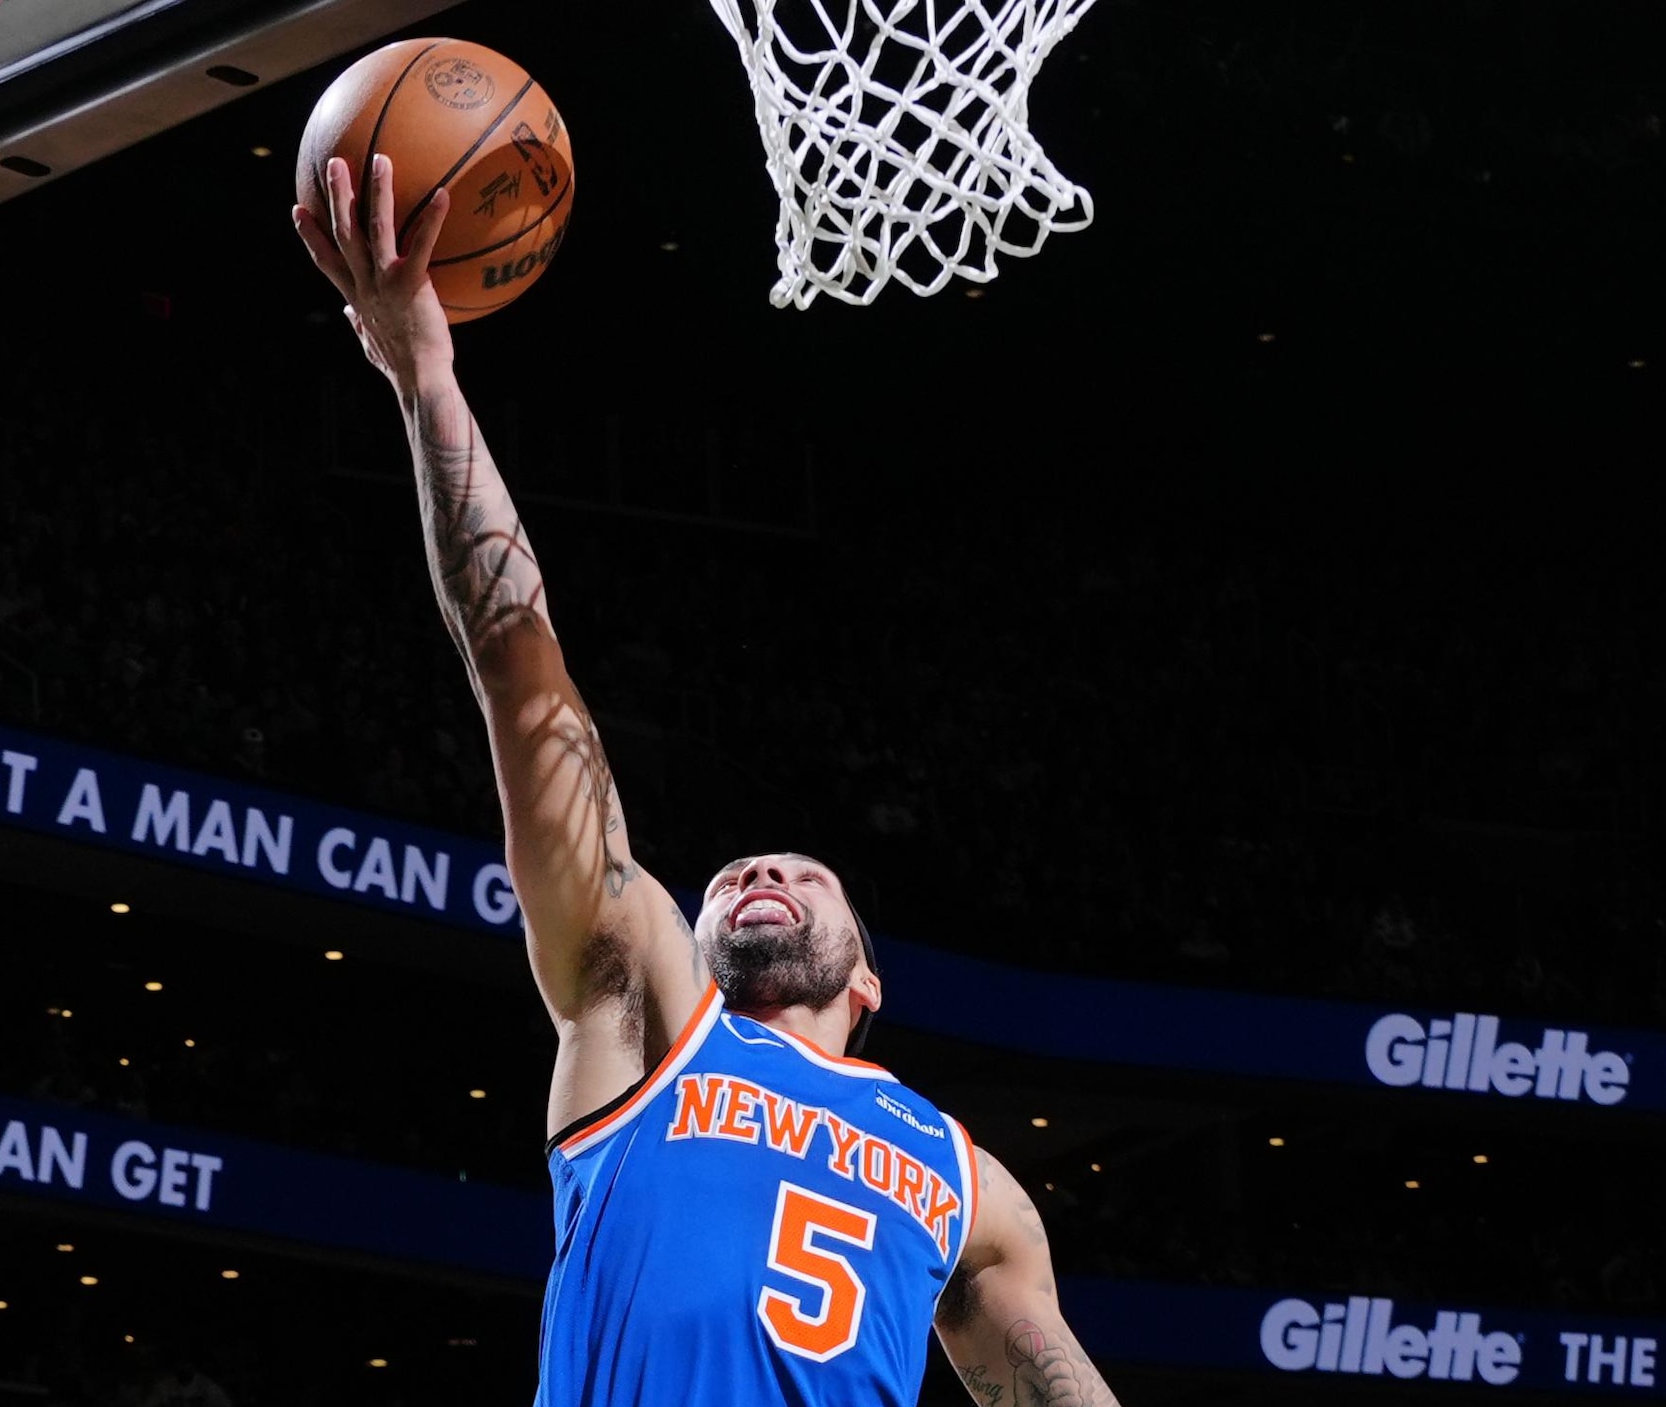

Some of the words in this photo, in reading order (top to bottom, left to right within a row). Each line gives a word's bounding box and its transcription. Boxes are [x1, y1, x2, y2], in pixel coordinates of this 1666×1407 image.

[58, 768, 106, 833] A
[132, 783, 293, 874] MAN
[318, 828, 450, 911] CAN
[1366, 1013, 1630, 1105] Gillette
[876, 1096, 902, 1119] abu
[902, 1112, 946, 1139] dhabi
[112, 1141, 222, 1210] GET
[666, 1073, 821, 1160] NEW
[823, 1107, 961, 1263] YORK
[757, 1180, 877, 1363] 5
[1261, 1297, 1522, 1385] Gillette
[1561, 1333, 1656, 1387] THE
